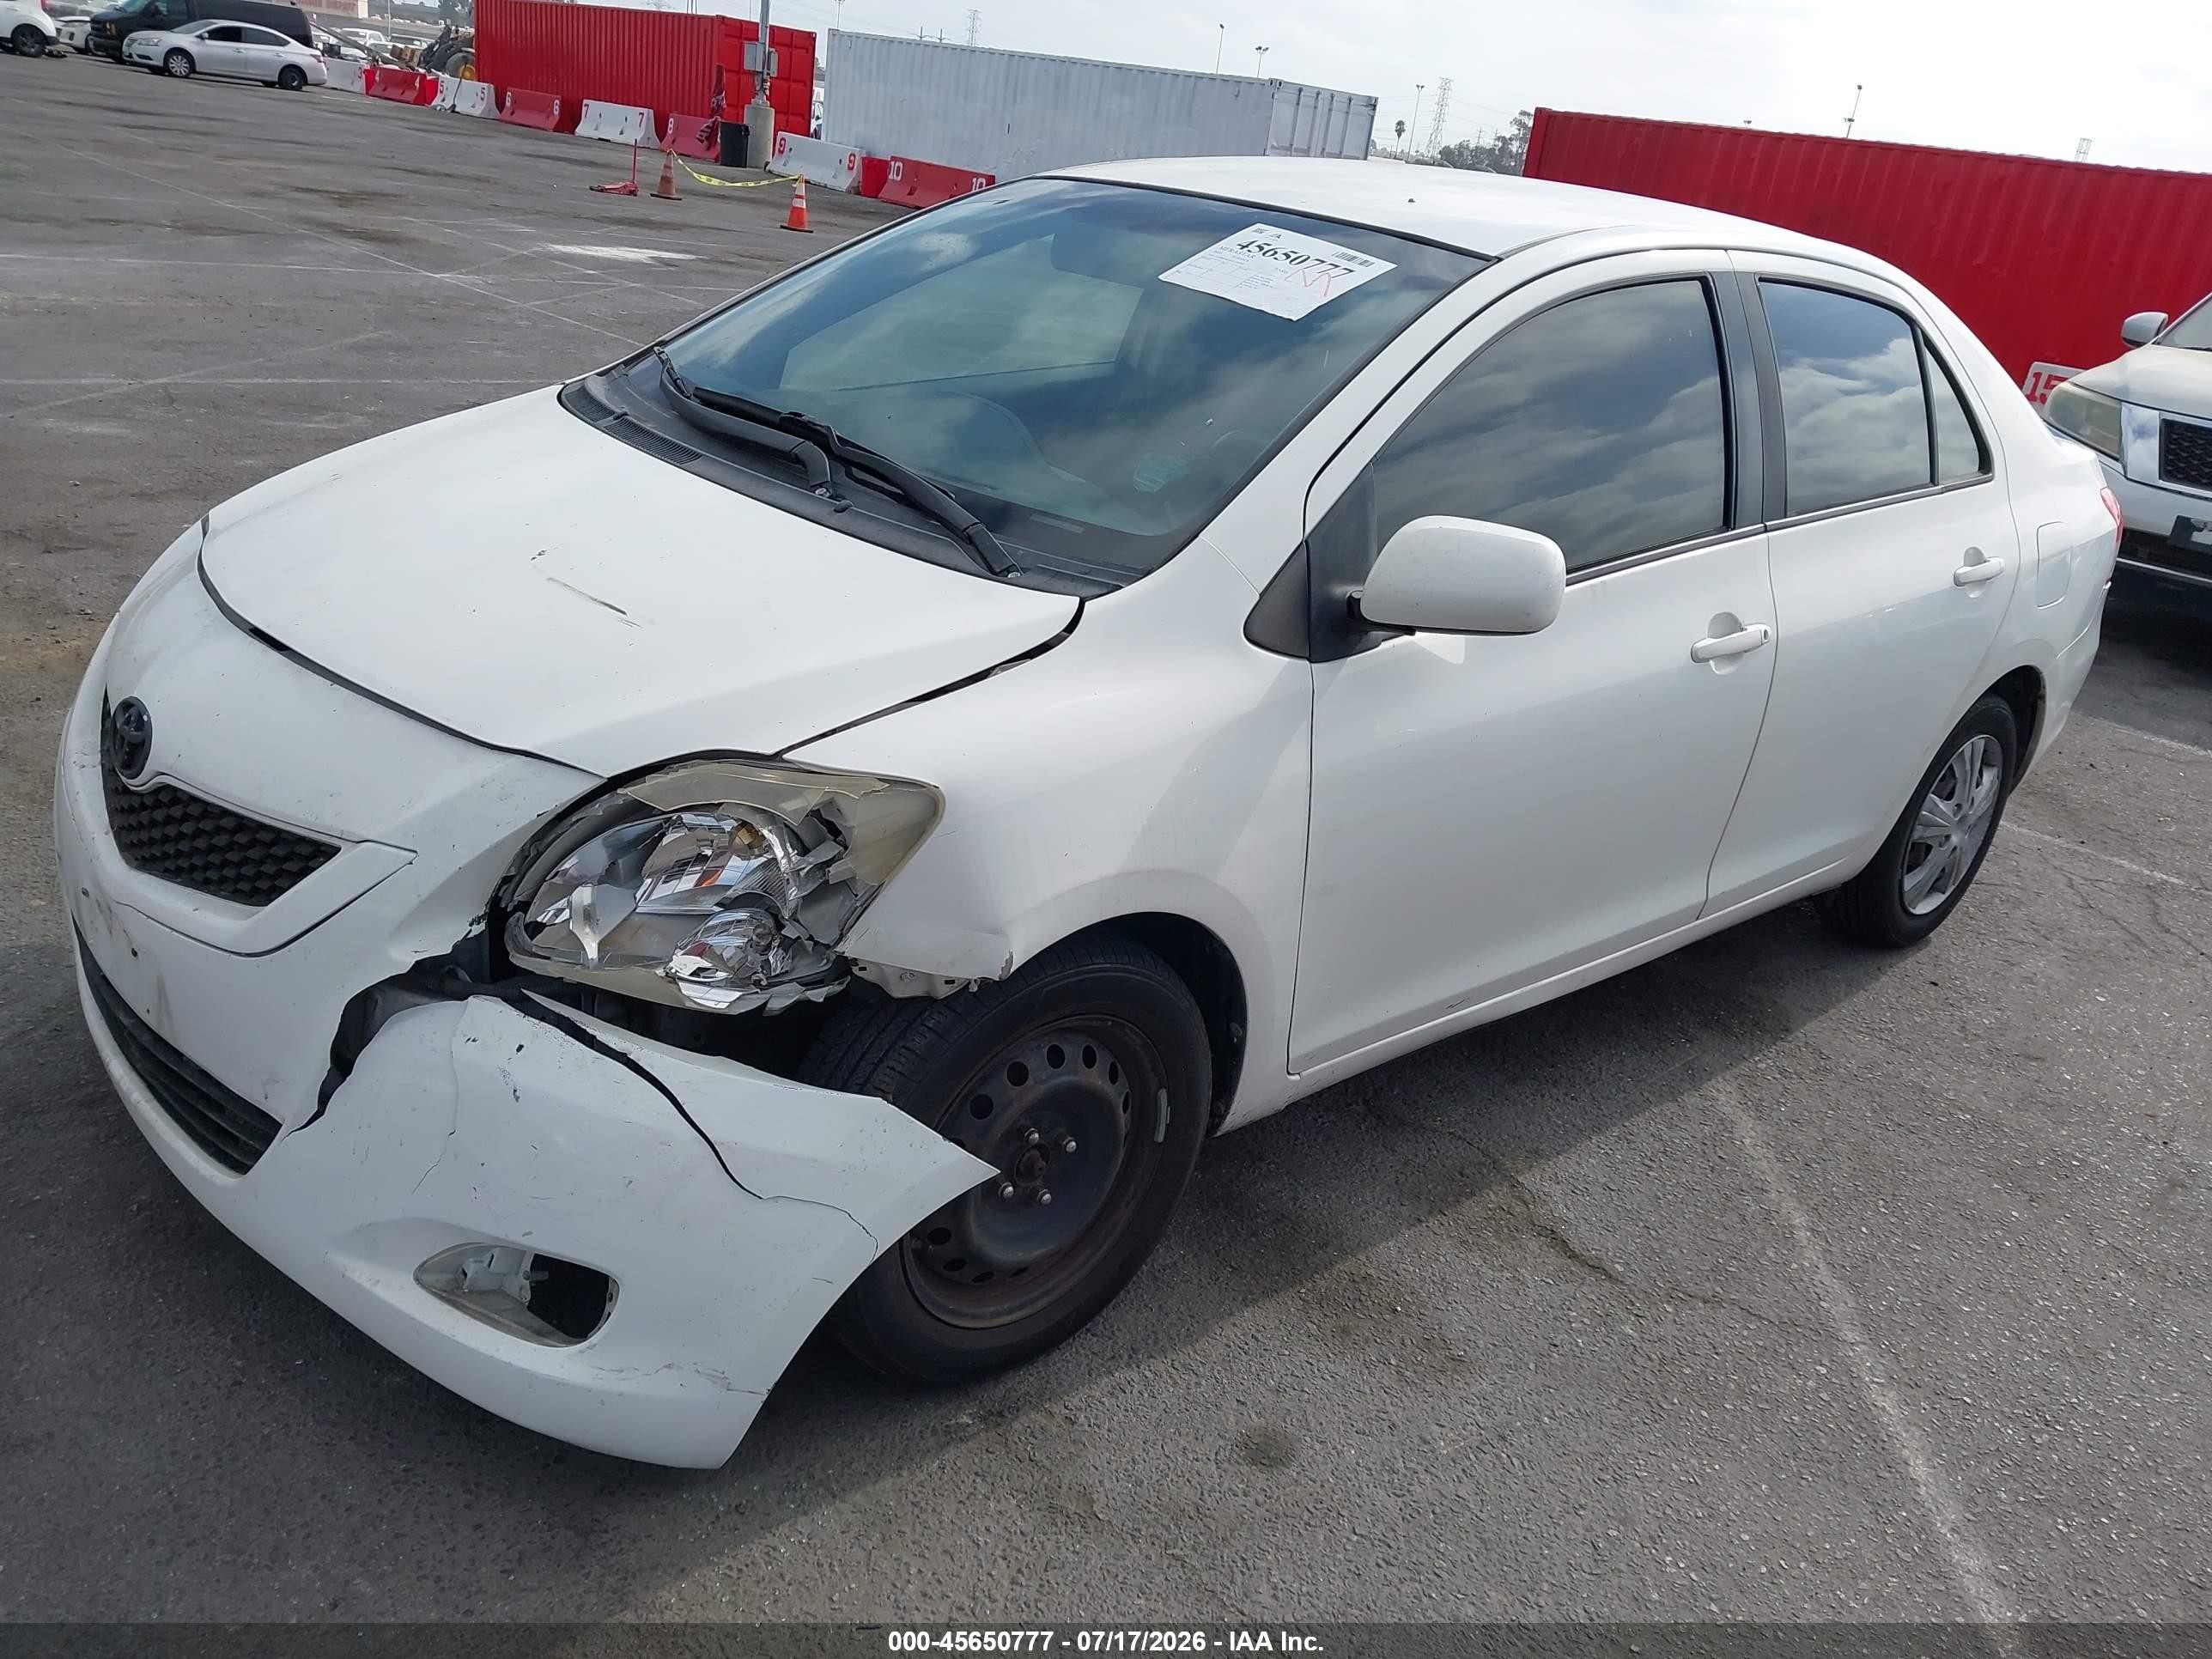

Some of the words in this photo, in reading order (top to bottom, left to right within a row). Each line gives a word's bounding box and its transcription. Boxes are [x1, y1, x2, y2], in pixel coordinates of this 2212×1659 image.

[414, 75, 420, 90] 4
[439, 80, 445, 94] 5
[480, 87, 486, 101] 5
[506, 91, 512, 106] 6
[553, 99, 560, 115] 6
[583, 104, 589, 119] 7
[638, 112, 645, 128] 7
[667, 117, 674, 134] 8
[778, 137, 787, 155] 9
[847, 153, 856, 171] 9
[888, 161, 902, 181] 10
[971, 177, 986, 192] 10
[1237, 240, 1357, 279] 45650777
